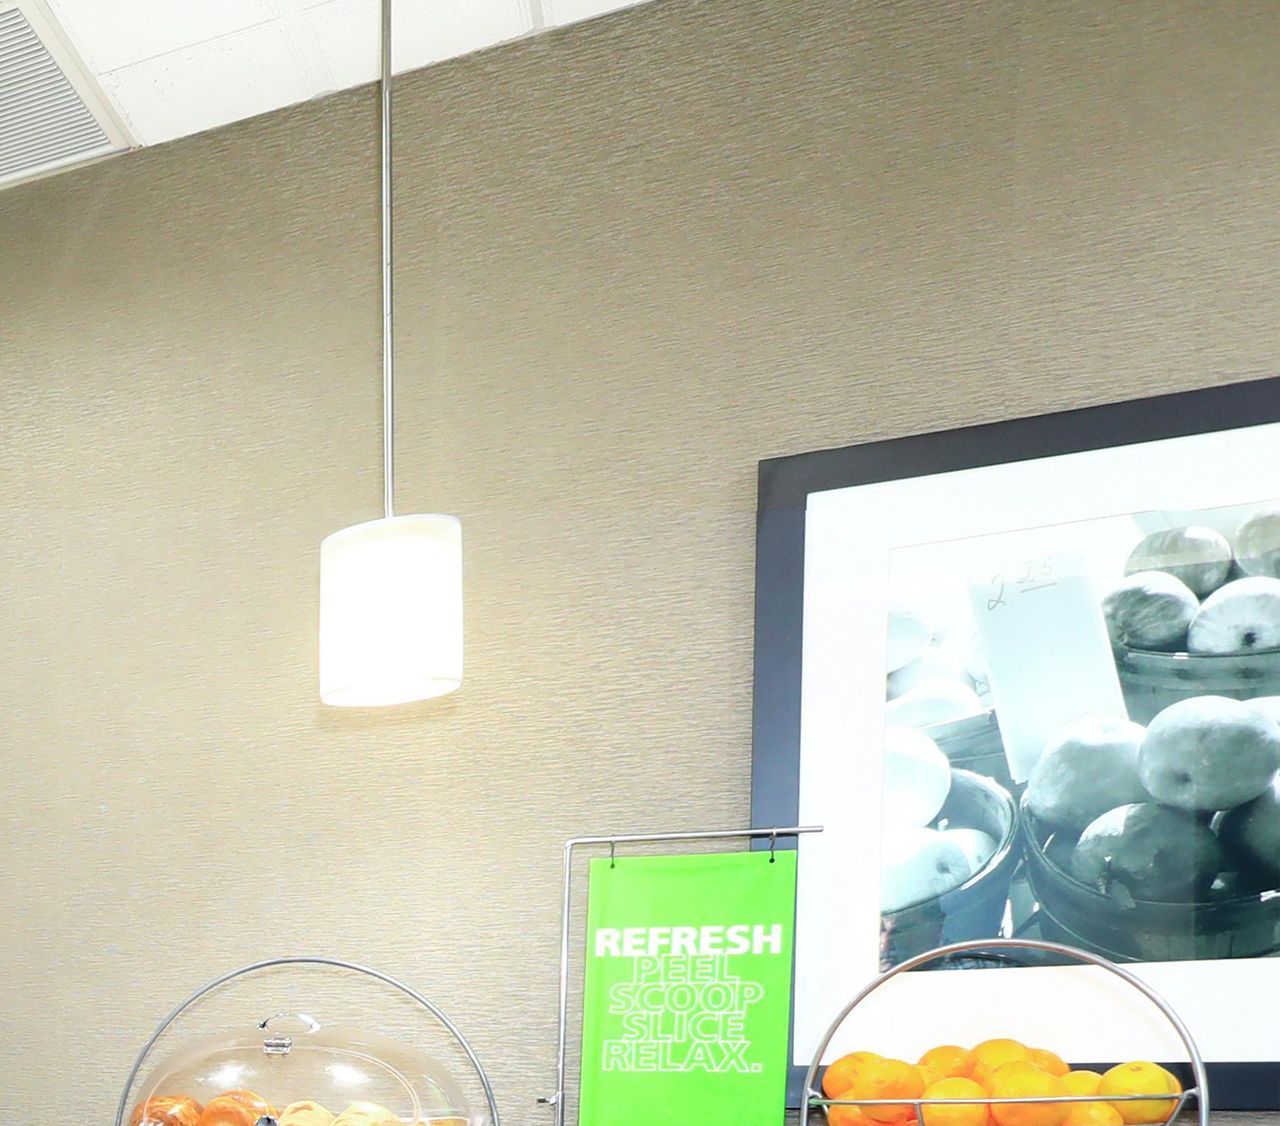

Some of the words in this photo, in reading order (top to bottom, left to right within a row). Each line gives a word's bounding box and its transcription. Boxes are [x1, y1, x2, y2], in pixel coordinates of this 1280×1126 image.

[595, 924, 782, 957] REFRESH
[633, 954, 740, 984] PEEL
[608, 981, 764, 1014] SCOOP
[622, 1010, 746, 1043] SLICE
[602, 1039, 763, 1072] RELAX.
